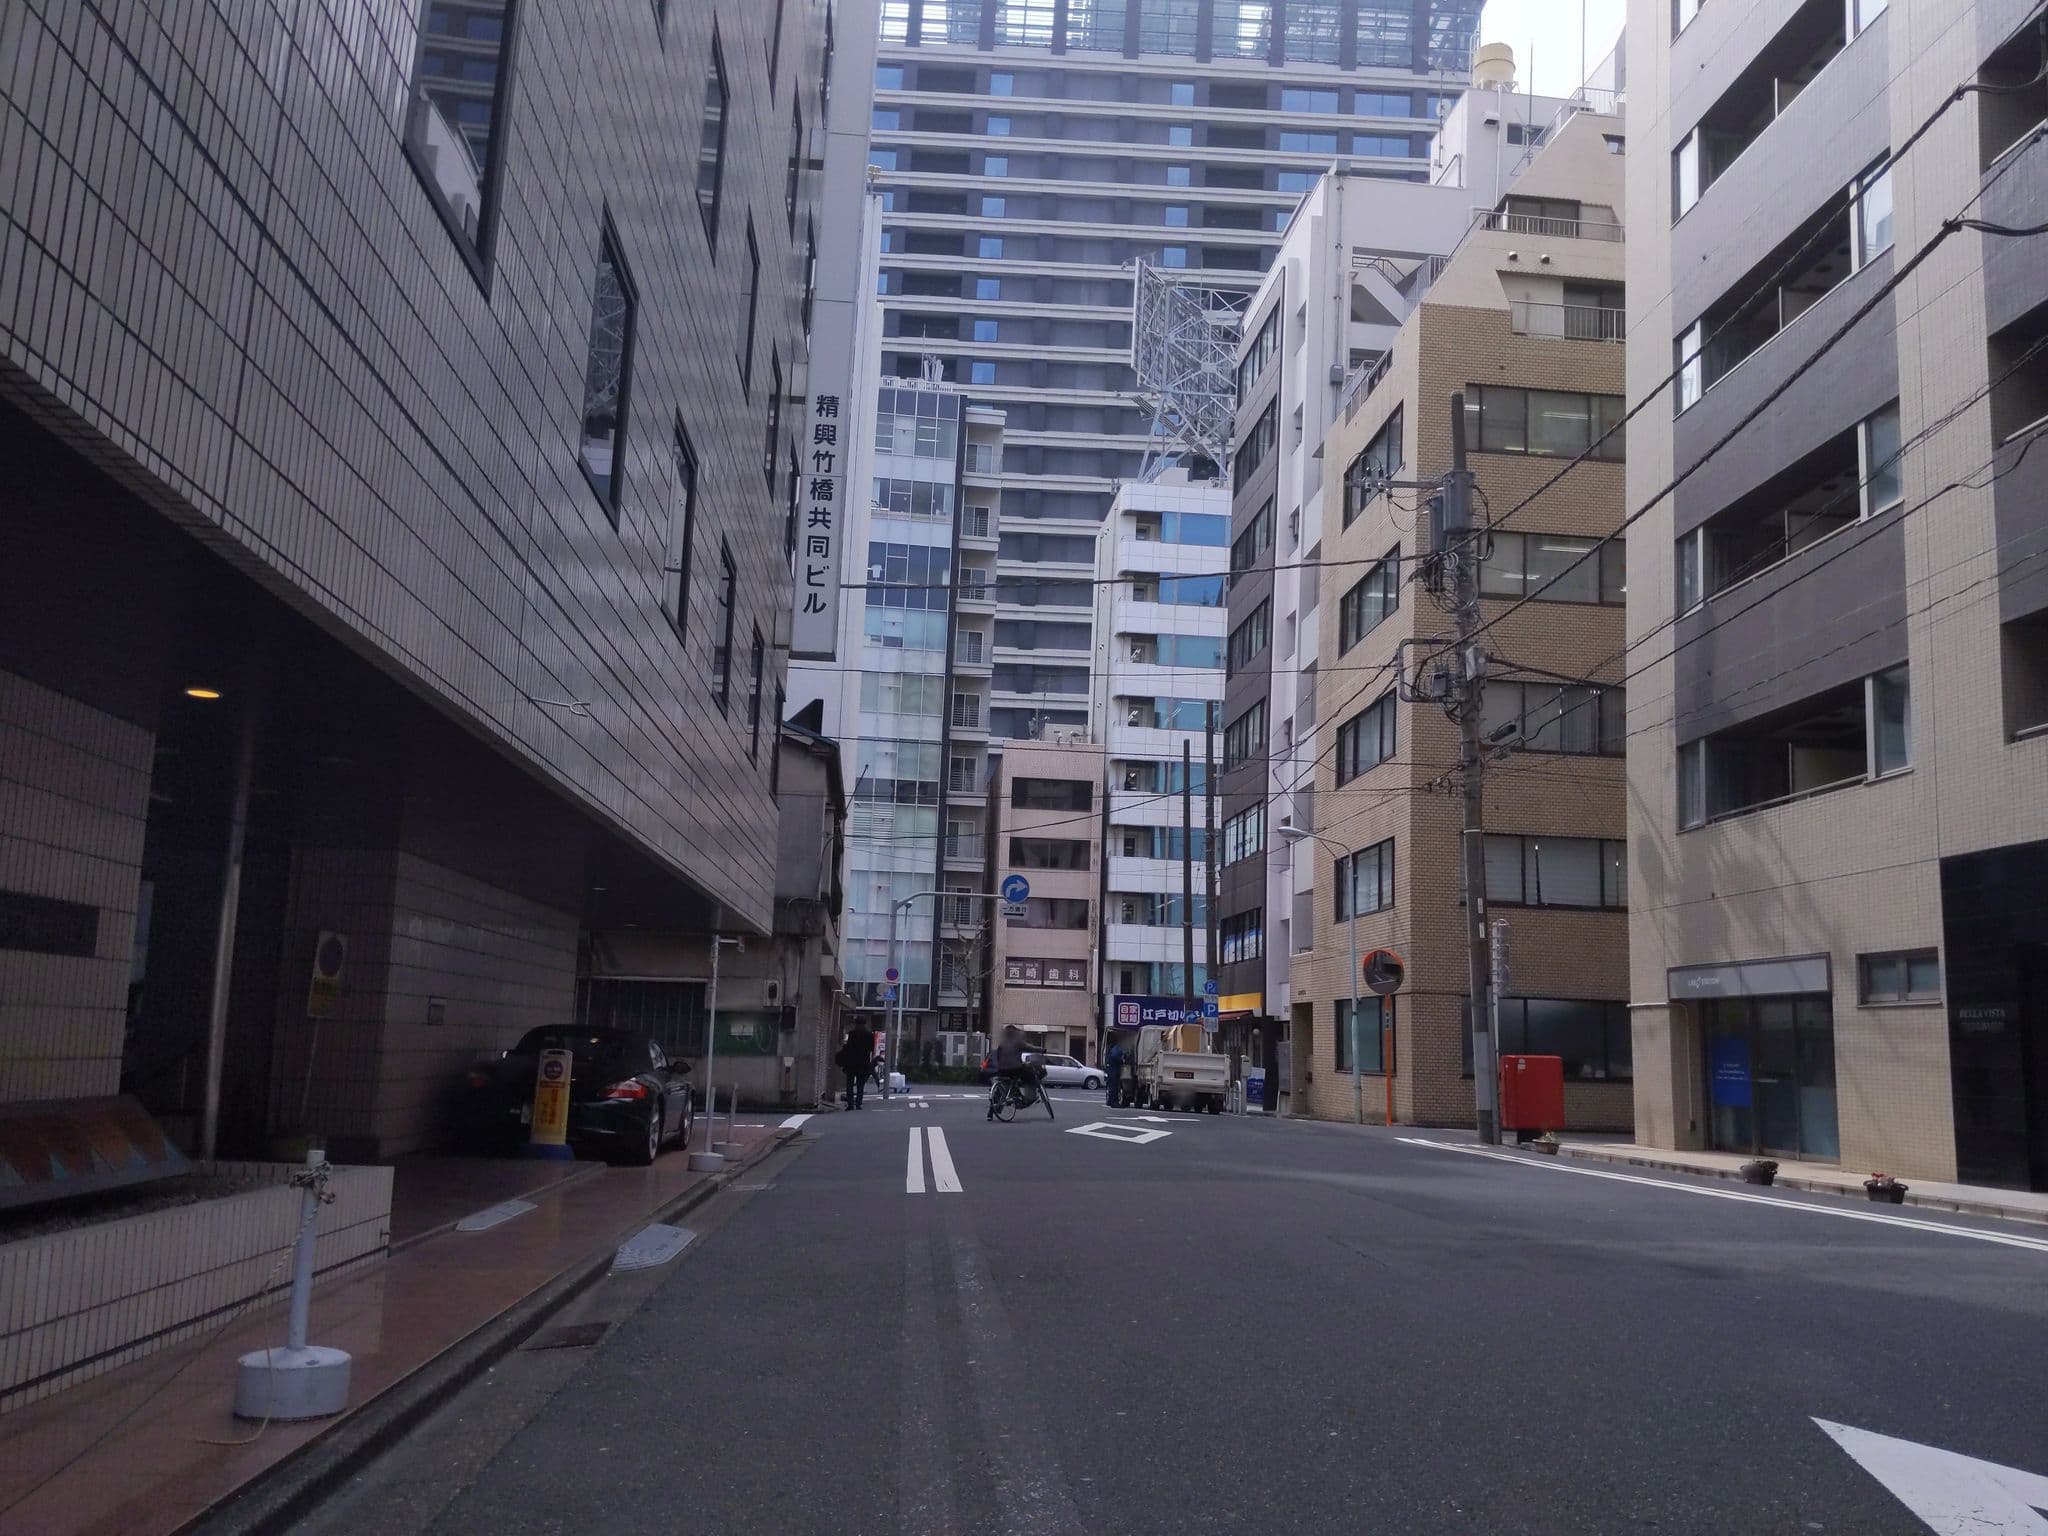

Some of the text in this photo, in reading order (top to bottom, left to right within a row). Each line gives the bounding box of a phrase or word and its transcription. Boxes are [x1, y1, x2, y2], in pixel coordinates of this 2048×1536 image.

[802, 394, 840, 614] 精興竹橋共同ビル
[1207, 1004, 1216, 1016] P
